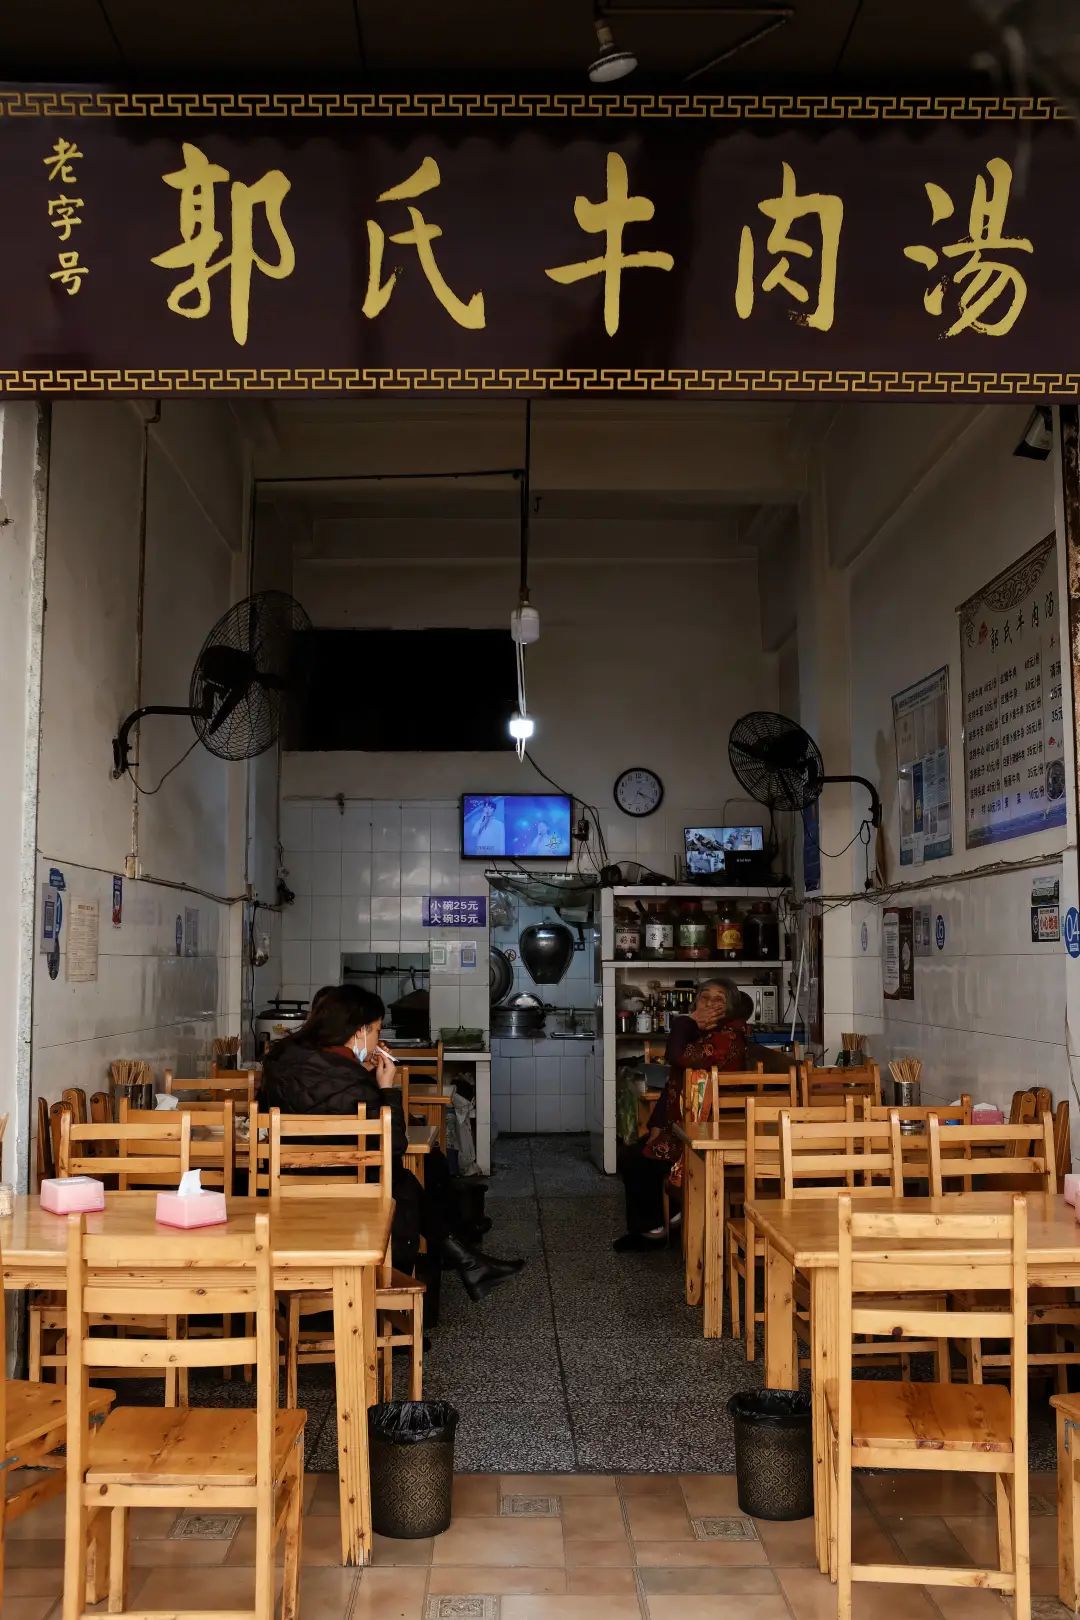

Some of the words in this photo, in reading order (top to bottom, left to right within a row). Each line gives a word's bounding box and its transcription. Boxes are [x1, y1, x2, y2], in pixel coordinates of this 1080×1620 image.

[43, 137, 89, 295] 老字号
[431, 901, 479, 911] 小碗25元
[431, 914, 479, 924] 大碗35元
